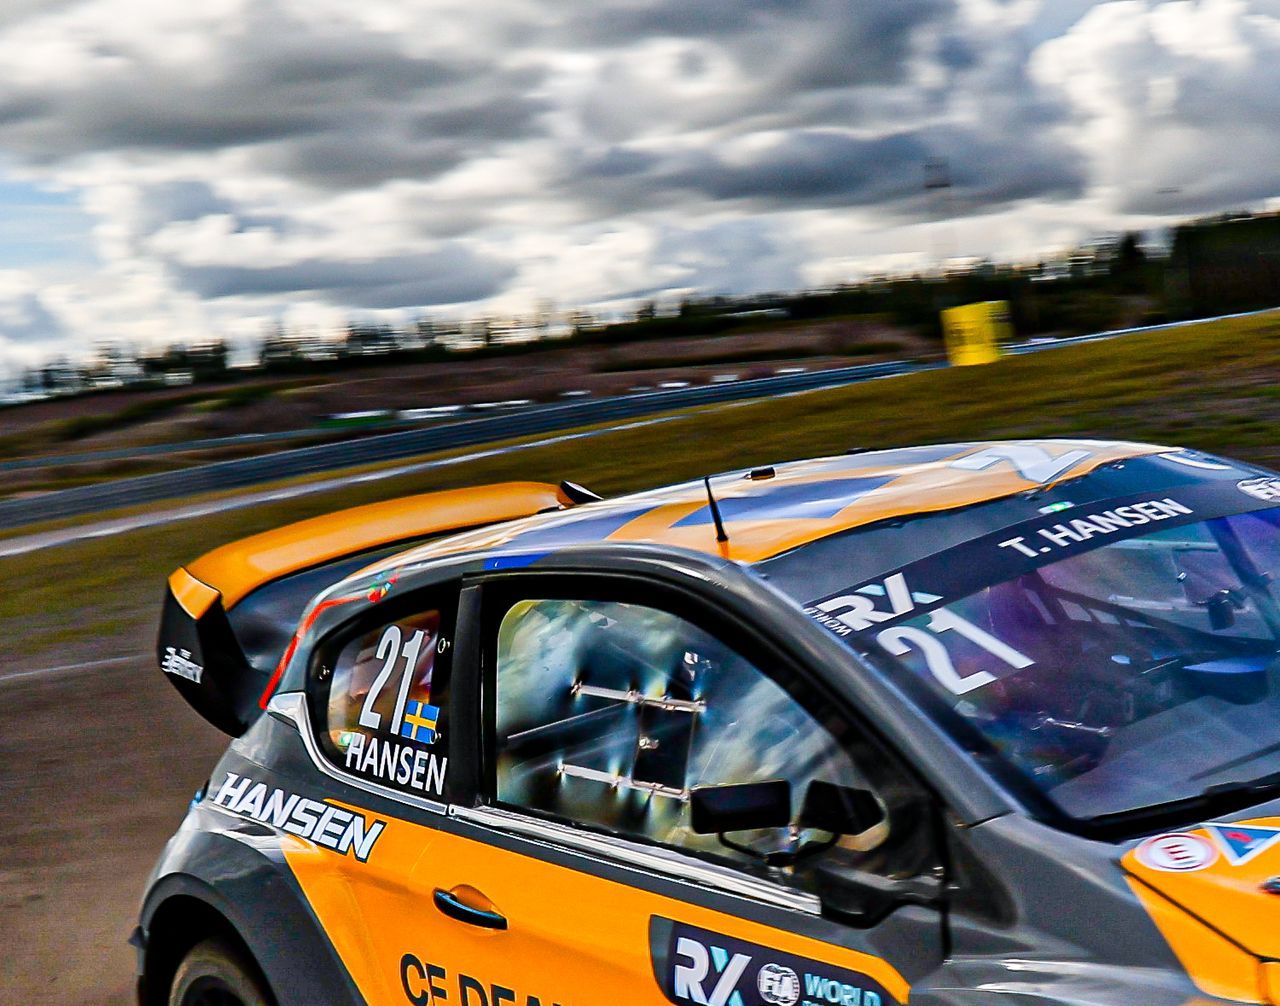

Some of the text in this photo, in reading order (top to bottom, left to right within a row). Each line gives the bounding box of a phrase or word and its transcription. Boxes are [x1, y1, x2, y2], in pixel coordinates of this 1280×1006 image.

[1045, 497, 1194, 548] HANSEN
[814, 571, 944, 632] RX
[359, 624, 425, 735] 21
[876, 607, 1036, 696] 21
[345, 732, 448, 796] HANSEN
[213, 772, 388, 863] HANSEN
